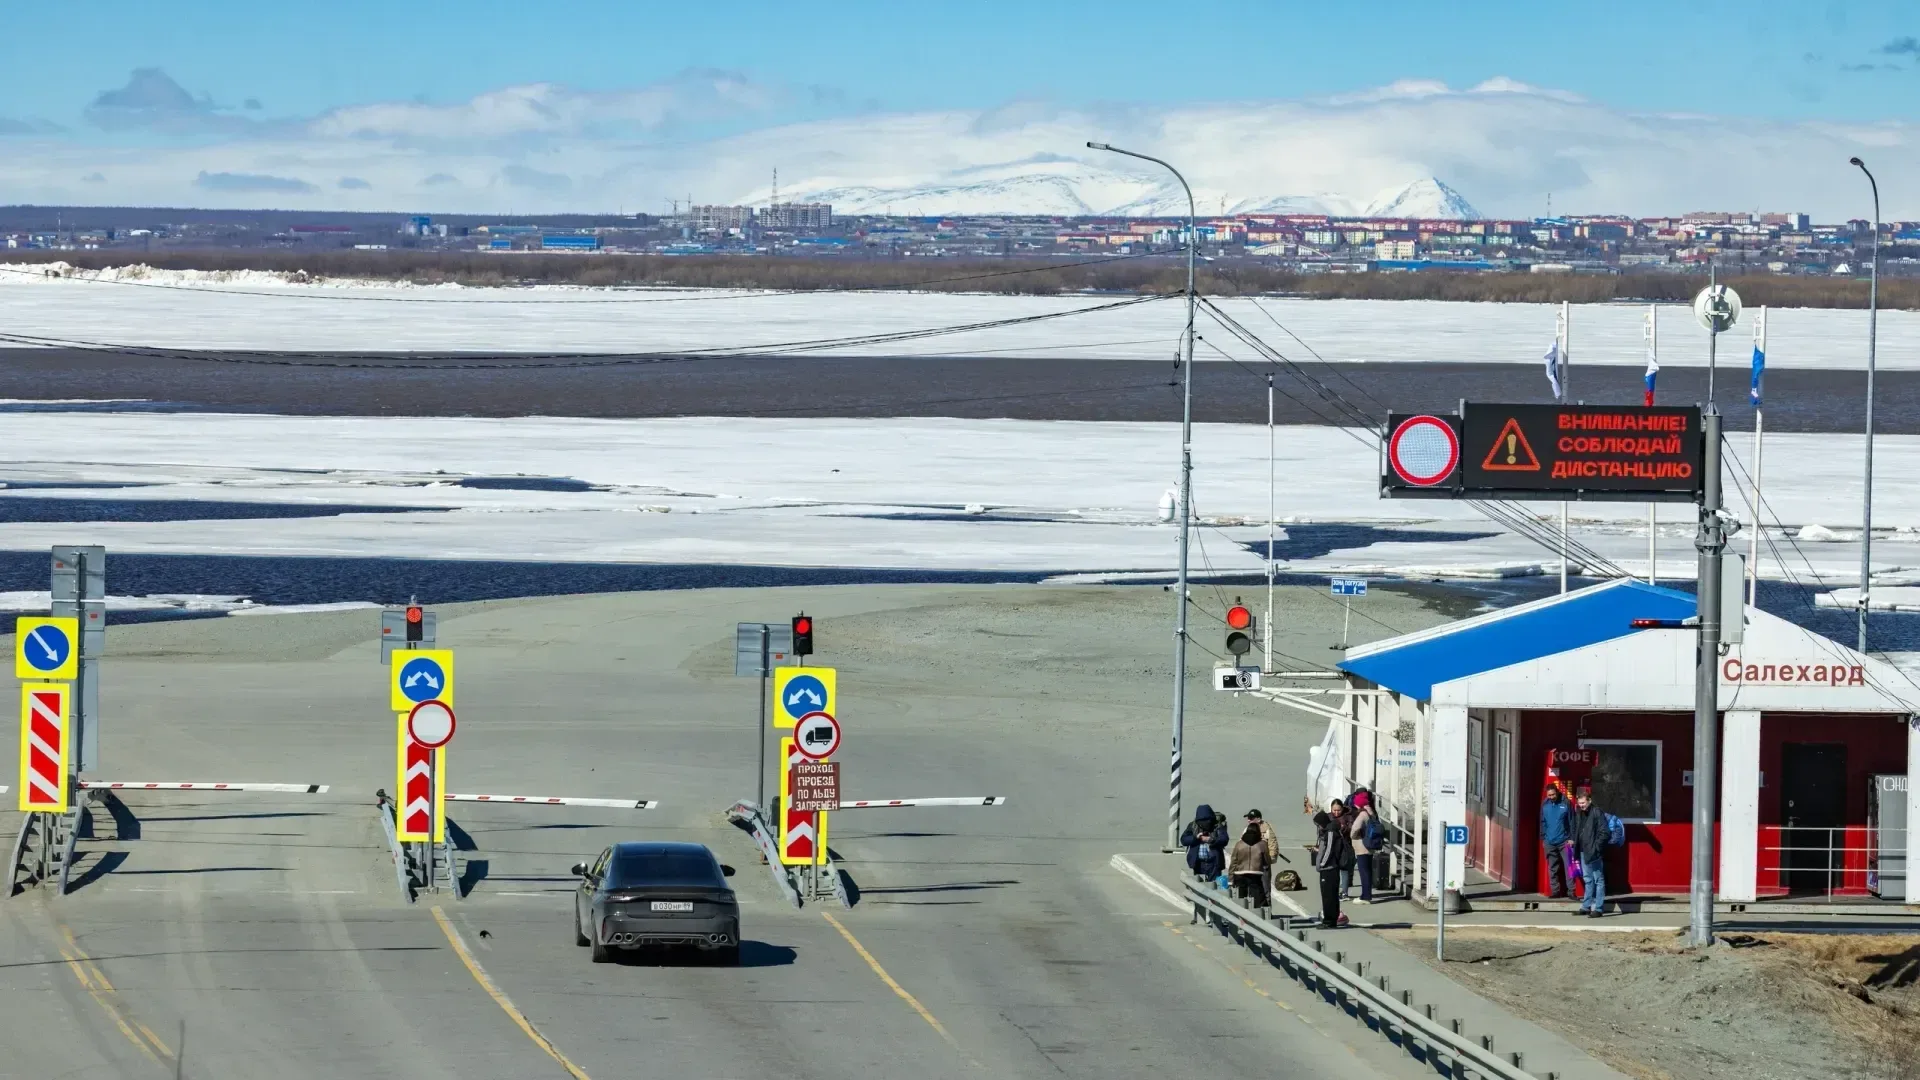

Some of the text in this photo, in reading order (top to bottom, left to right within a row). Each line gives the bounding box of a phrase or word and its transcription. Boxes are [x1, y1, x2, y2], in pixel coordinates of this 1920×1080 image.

[1558, 414, 1687, 430] ВНИМАНИЕ!
[1558, 434, 1681, 455] СОБЛЮДАЙ
[1551, 461, 1692, 479] ДИСТАНЦИЮ
[1723, 659, 1865, 686] Салехард
[1553, 751, 1590, 762] КОФЕ
[798, 764, 834, 773] ПРОХОД
[797, 776, 835, 786] ПРОЕЗД
[797, 788, 836, 799] ПО ЛЬДУ
[1450, 828, 1465, 842] 13
